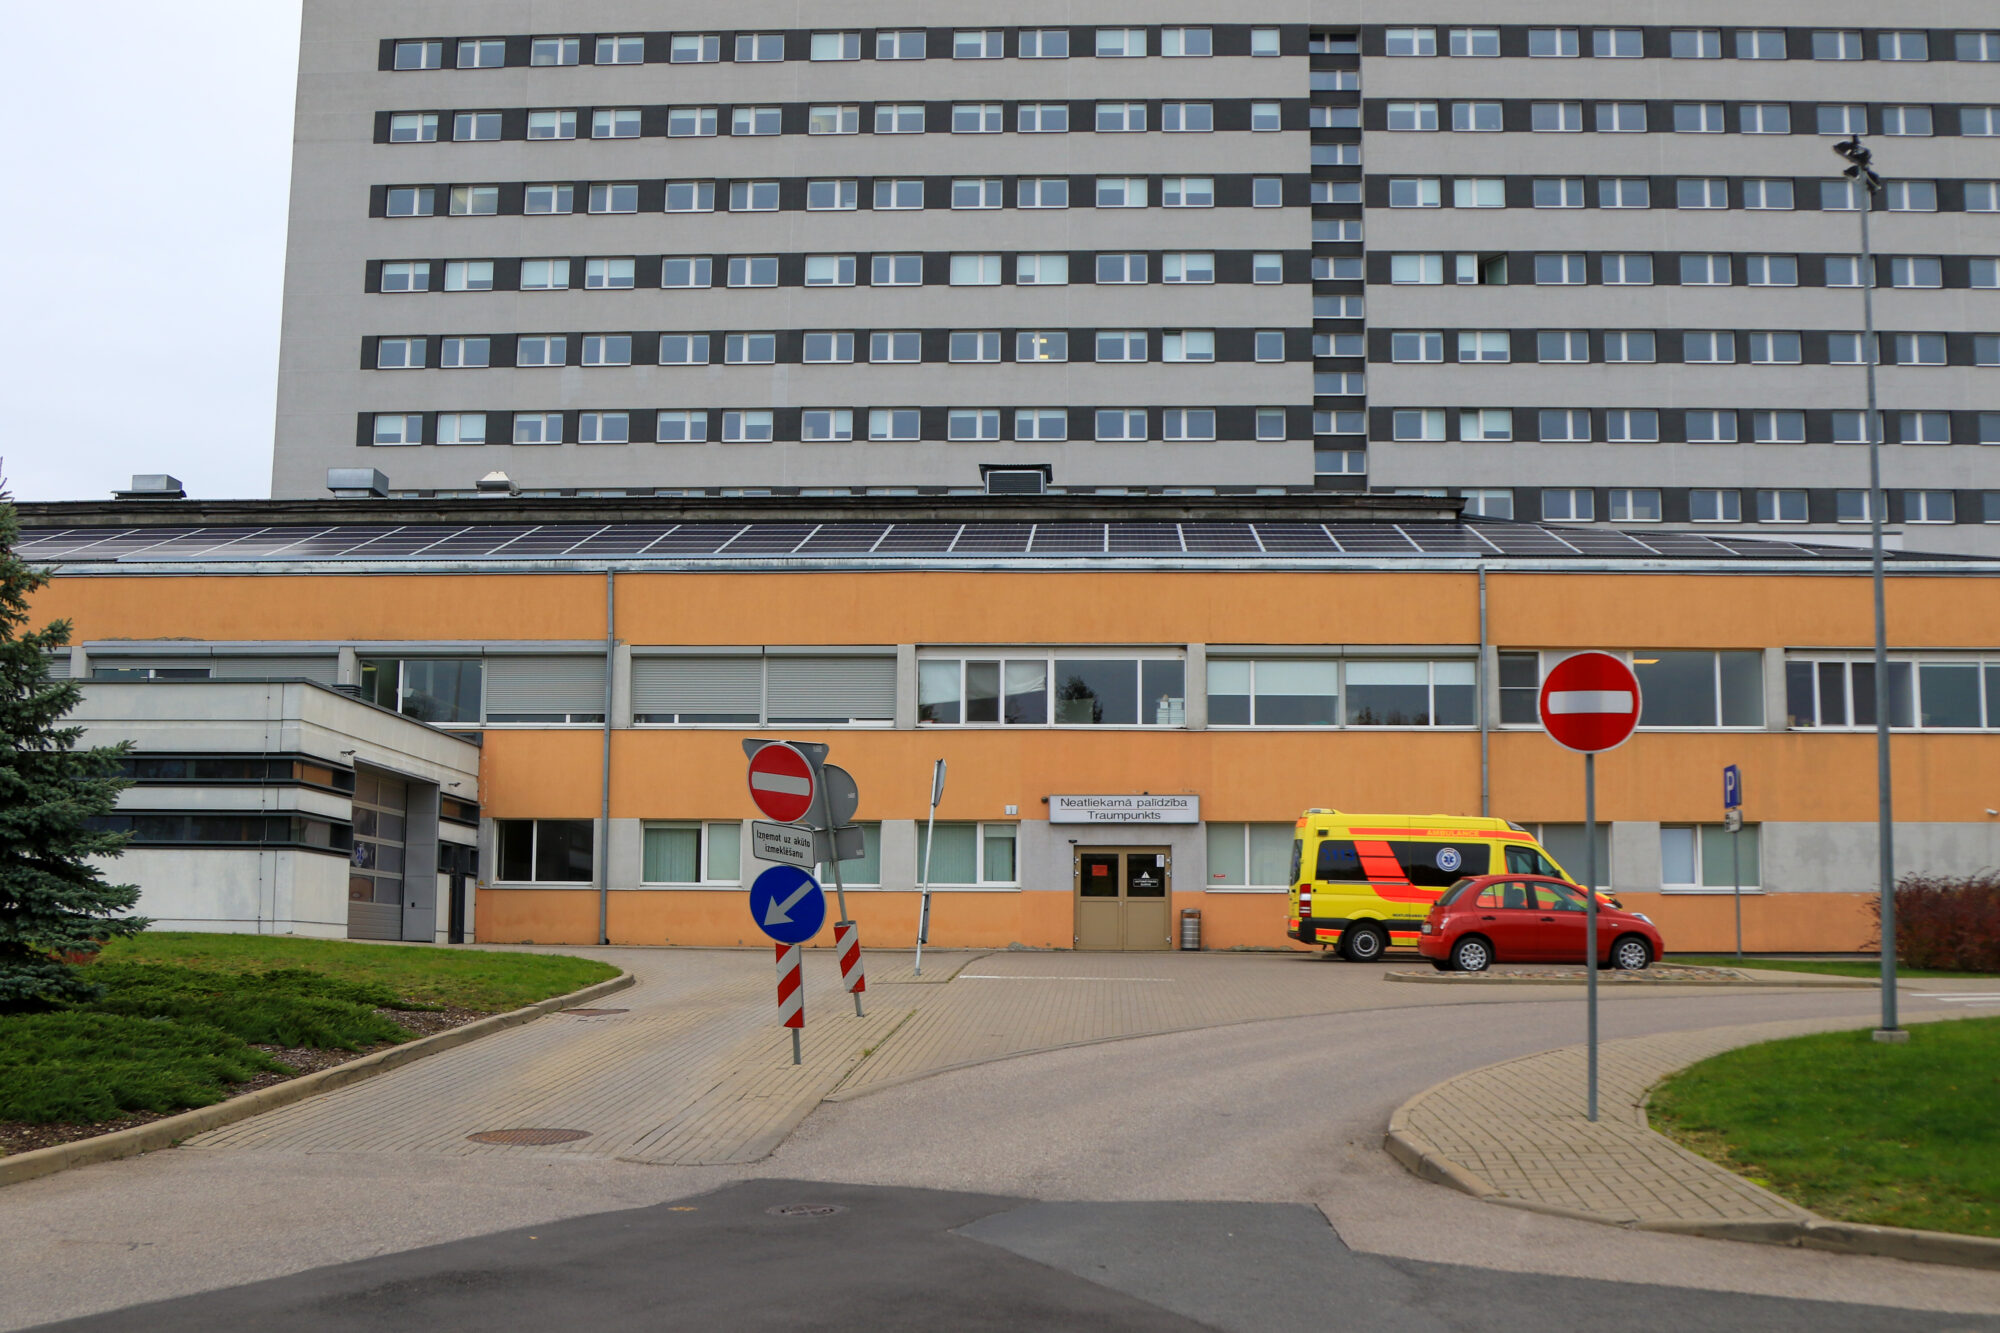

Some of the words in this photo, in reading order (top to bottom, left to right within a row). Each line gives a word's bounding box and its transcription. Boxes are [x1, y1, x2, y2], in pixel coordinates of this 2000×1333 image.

[1727, 771, 1735, 803] P
[1060, 798, 1132, 807] Neatliekamā
[1137, 798, 1187, 808] palīdzība
[1087, 811, 1161, 821] Traumpunkts
[756, 829, 781, 842] Izņemot
[794, 837, 810, 848] akūto
[1426, 829, 1480, 837] AMBULANCE
[765, 844, 803, 858] izmeklēšanu
